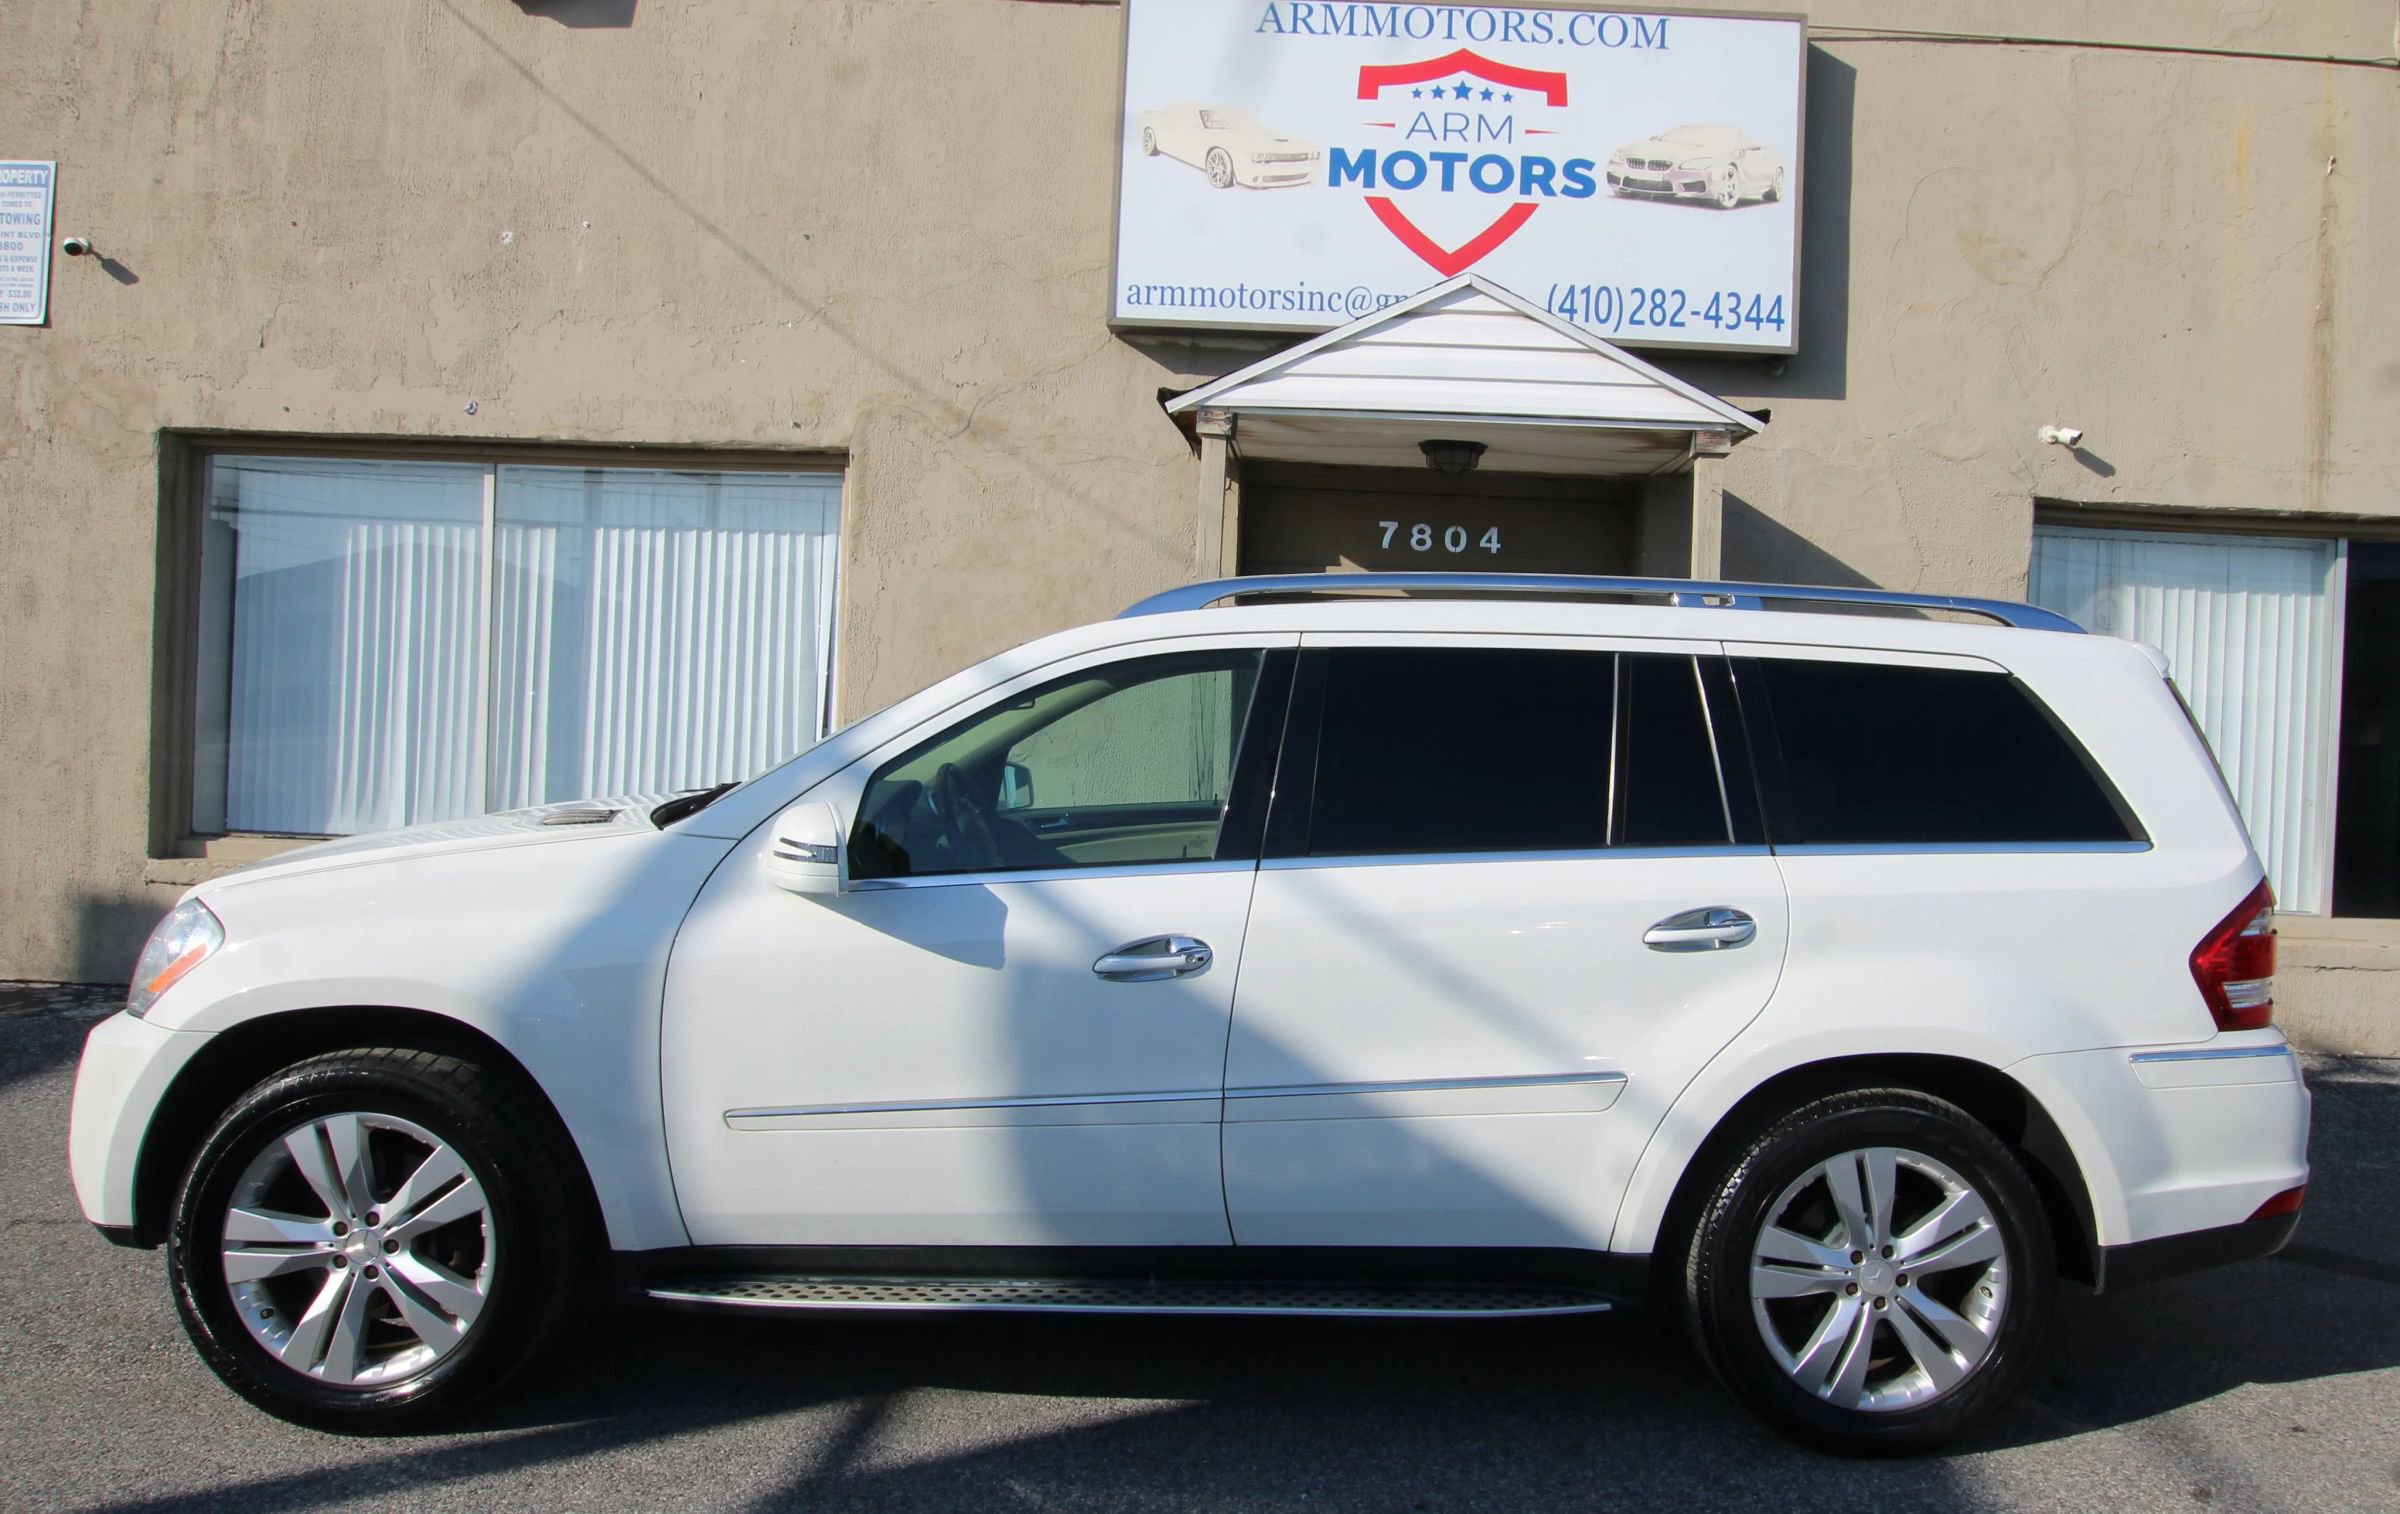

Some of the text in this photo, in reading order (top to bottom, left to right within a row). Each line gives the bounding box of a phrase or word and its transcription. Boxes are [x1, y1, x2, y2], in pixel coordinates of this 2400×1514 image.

[1254, 1, 1671, 50] ARMMOTORS.COM
[1405, 110, 1514, 144] ARM
[0, 169, 48, 185] OPERTY
[1327, 147, 1597, 200] MOTORS
[12, 302, 36, 312] ONLY
[1547, 283, 1786, 332] (410)282-4344
[1379, 520, 1501, 554] 7804
